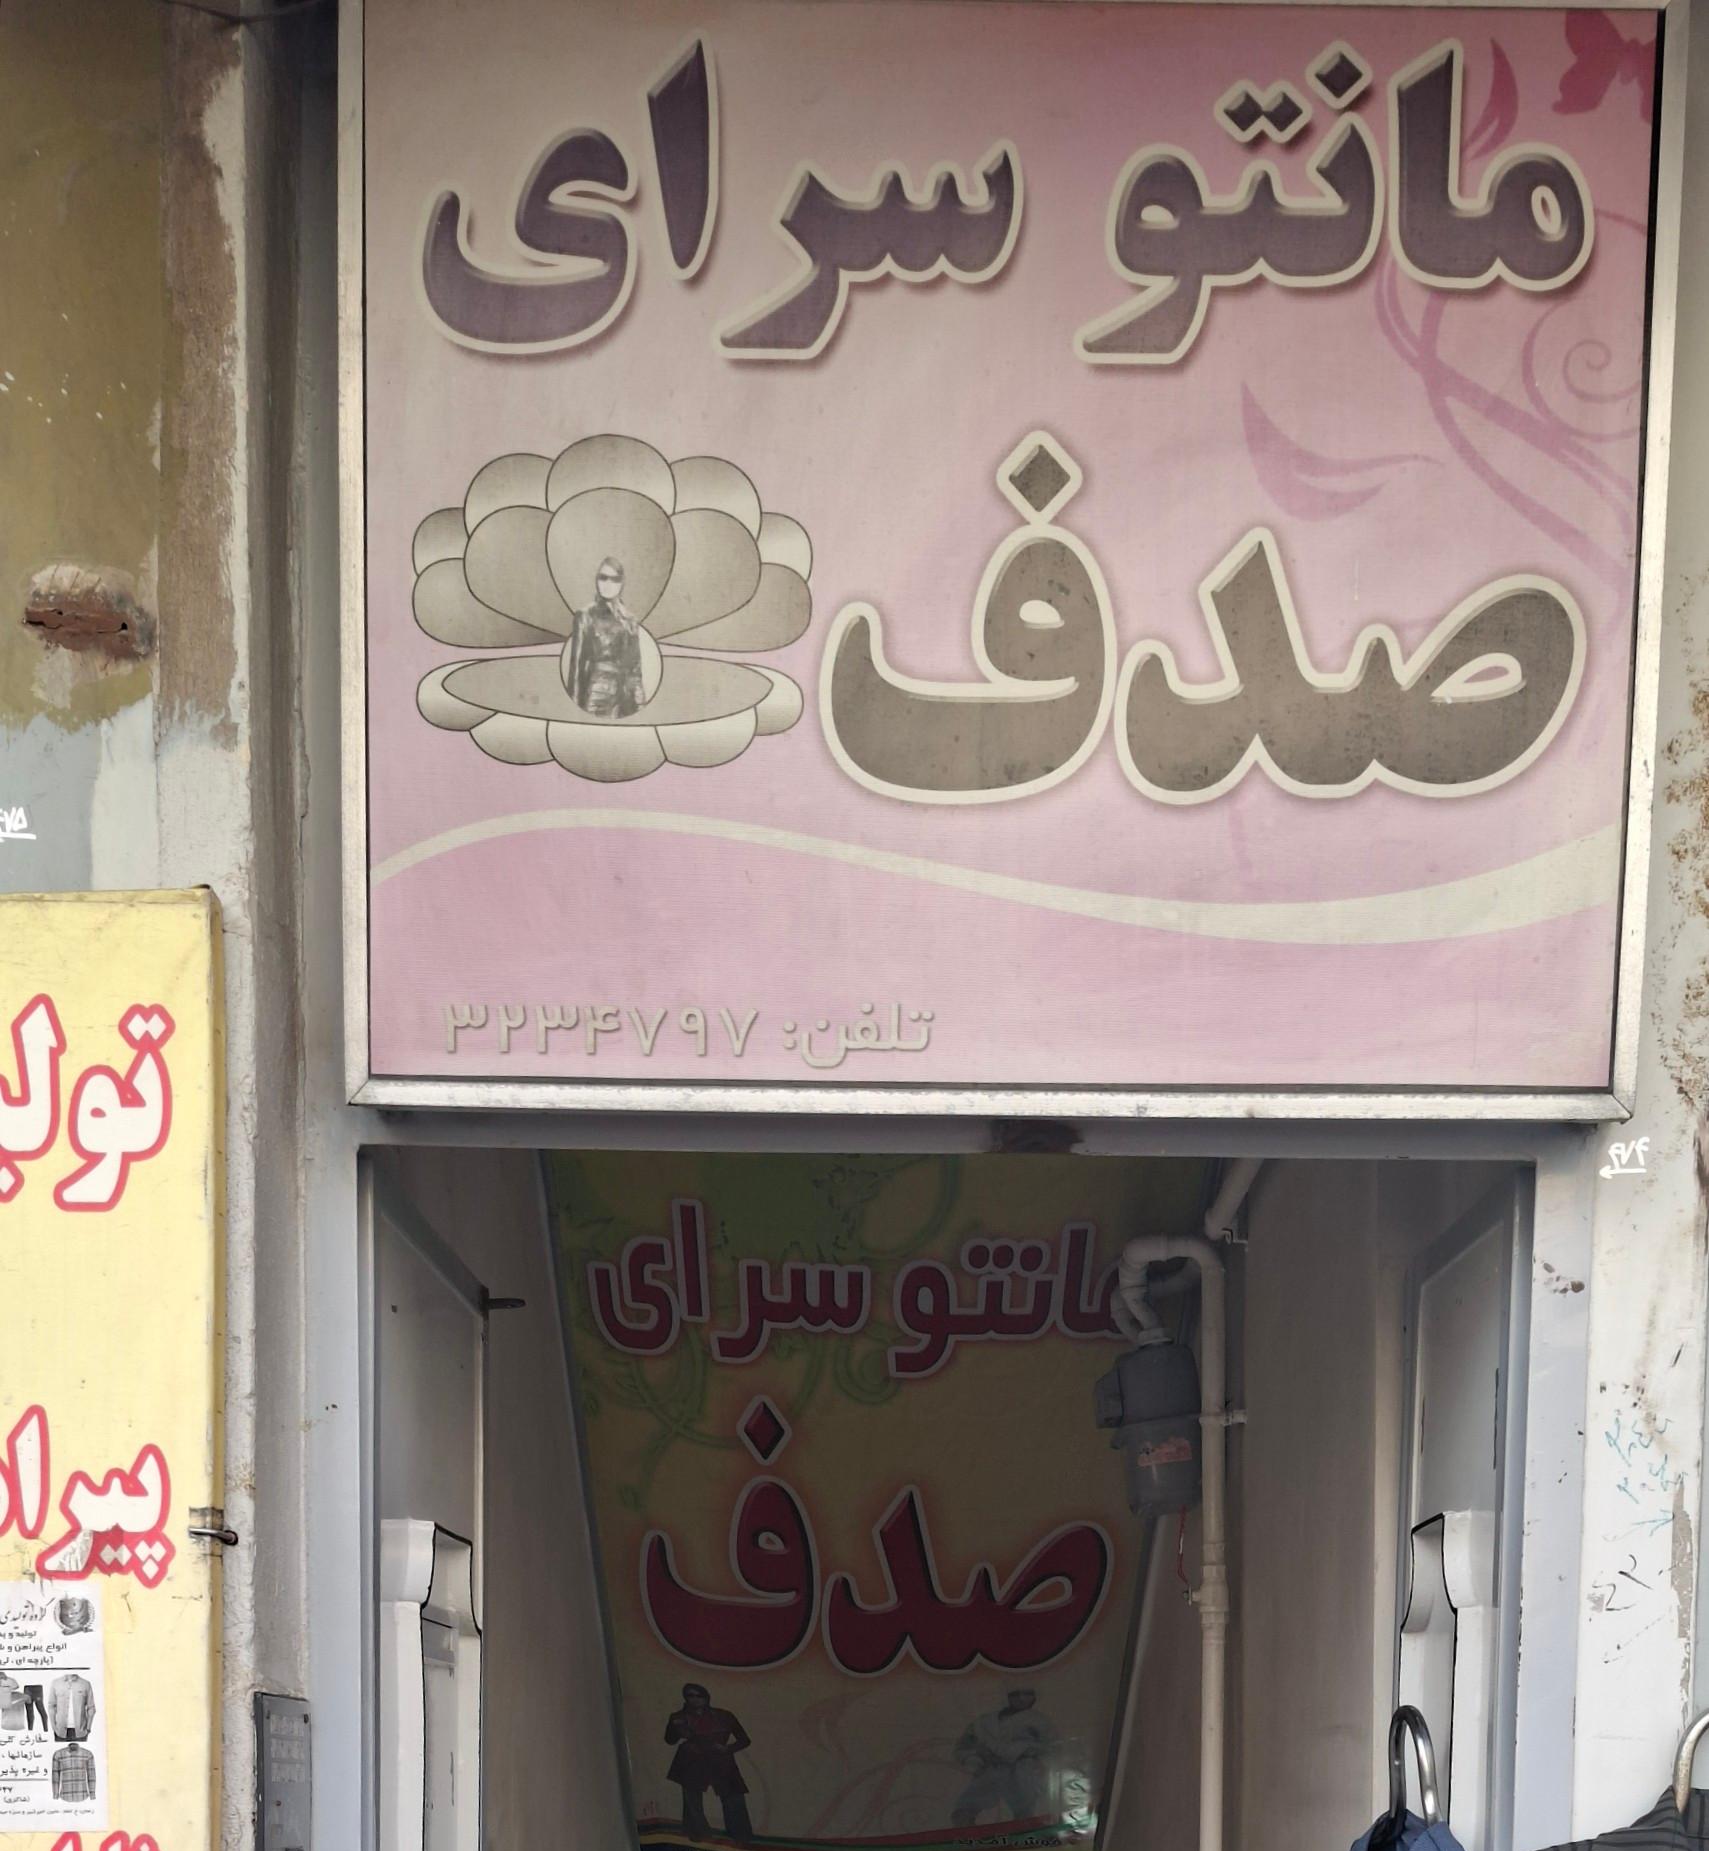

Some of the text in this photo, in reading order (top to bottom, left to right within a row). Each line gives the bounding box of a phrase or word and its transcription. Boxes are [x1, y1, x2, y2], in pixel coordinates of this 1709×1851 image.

[416, 34, 1595, 364] مانتو سرای
[819, 430, 1588, 804] صدف
[446, 1001, 935, 1068] تلفن: ۳۲۳۴۷۹۷
[588, 1198, 872, 1364] سرای
[640, 1393, 1115, 1678] صدف
